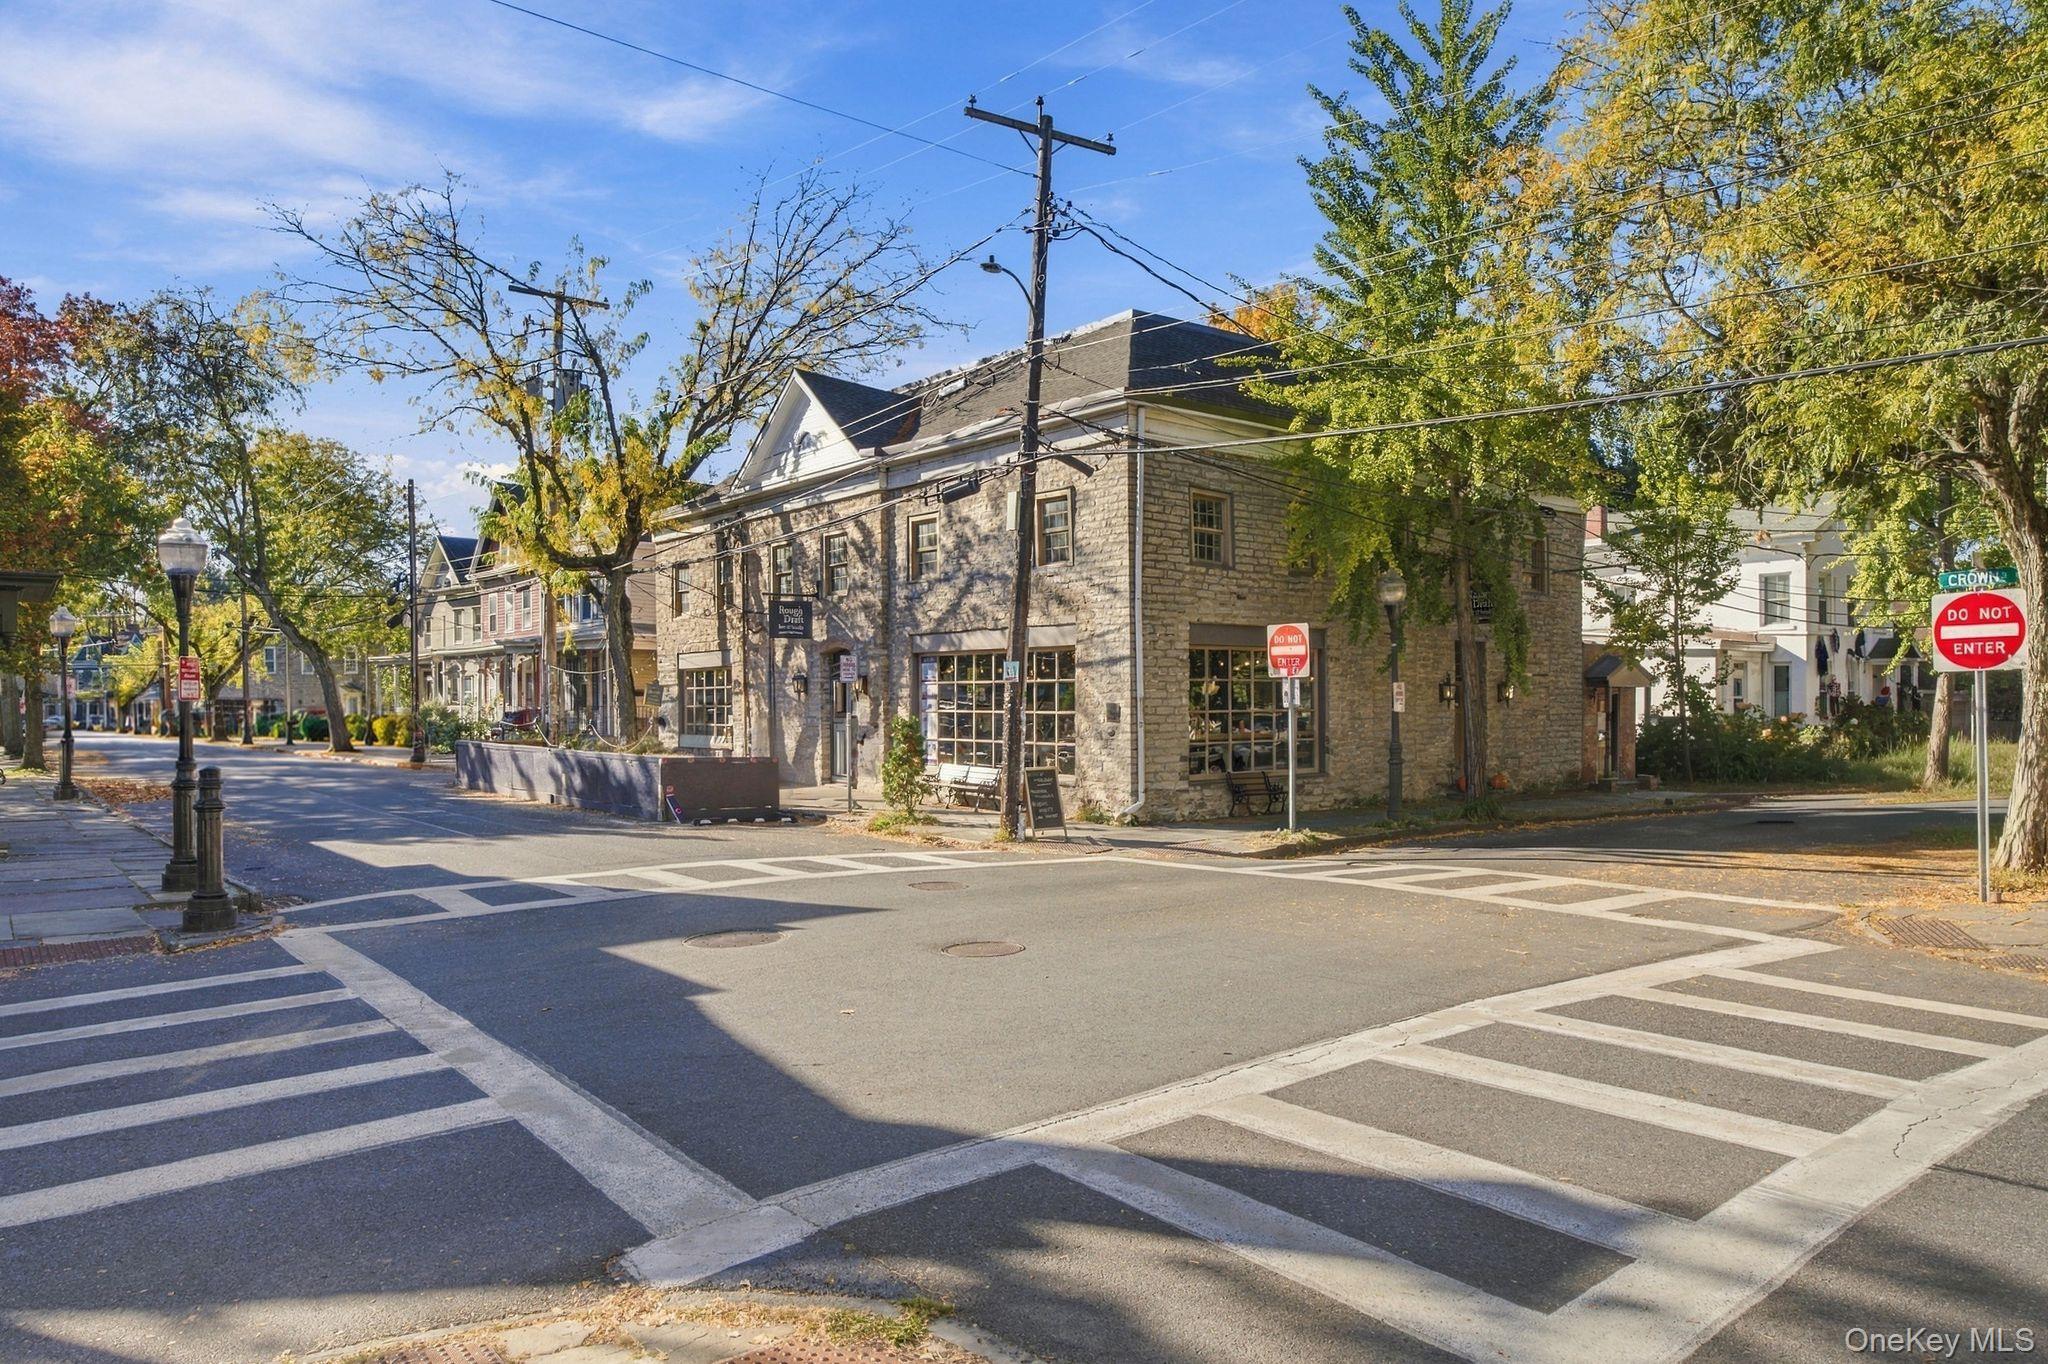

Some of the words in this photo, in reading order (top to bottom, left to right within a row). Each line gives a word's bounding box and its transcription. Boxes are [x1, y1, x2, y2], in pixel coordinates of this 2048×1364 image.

[1948, 571, 2000, 587] CROWN
[778, 605, 803, 617] Rough
[1947, 609, 1968, 621] DO
[1979, 606, 2012, 620] NOT
[783, 614, 804, 624] Draft
[1274, 635, 1285, 645] DO
[1287, 634, 1303, 644] NOT
[1953, 641, 2006, 655] ENTER
[1277, 657, 1301, 667] ENTER
